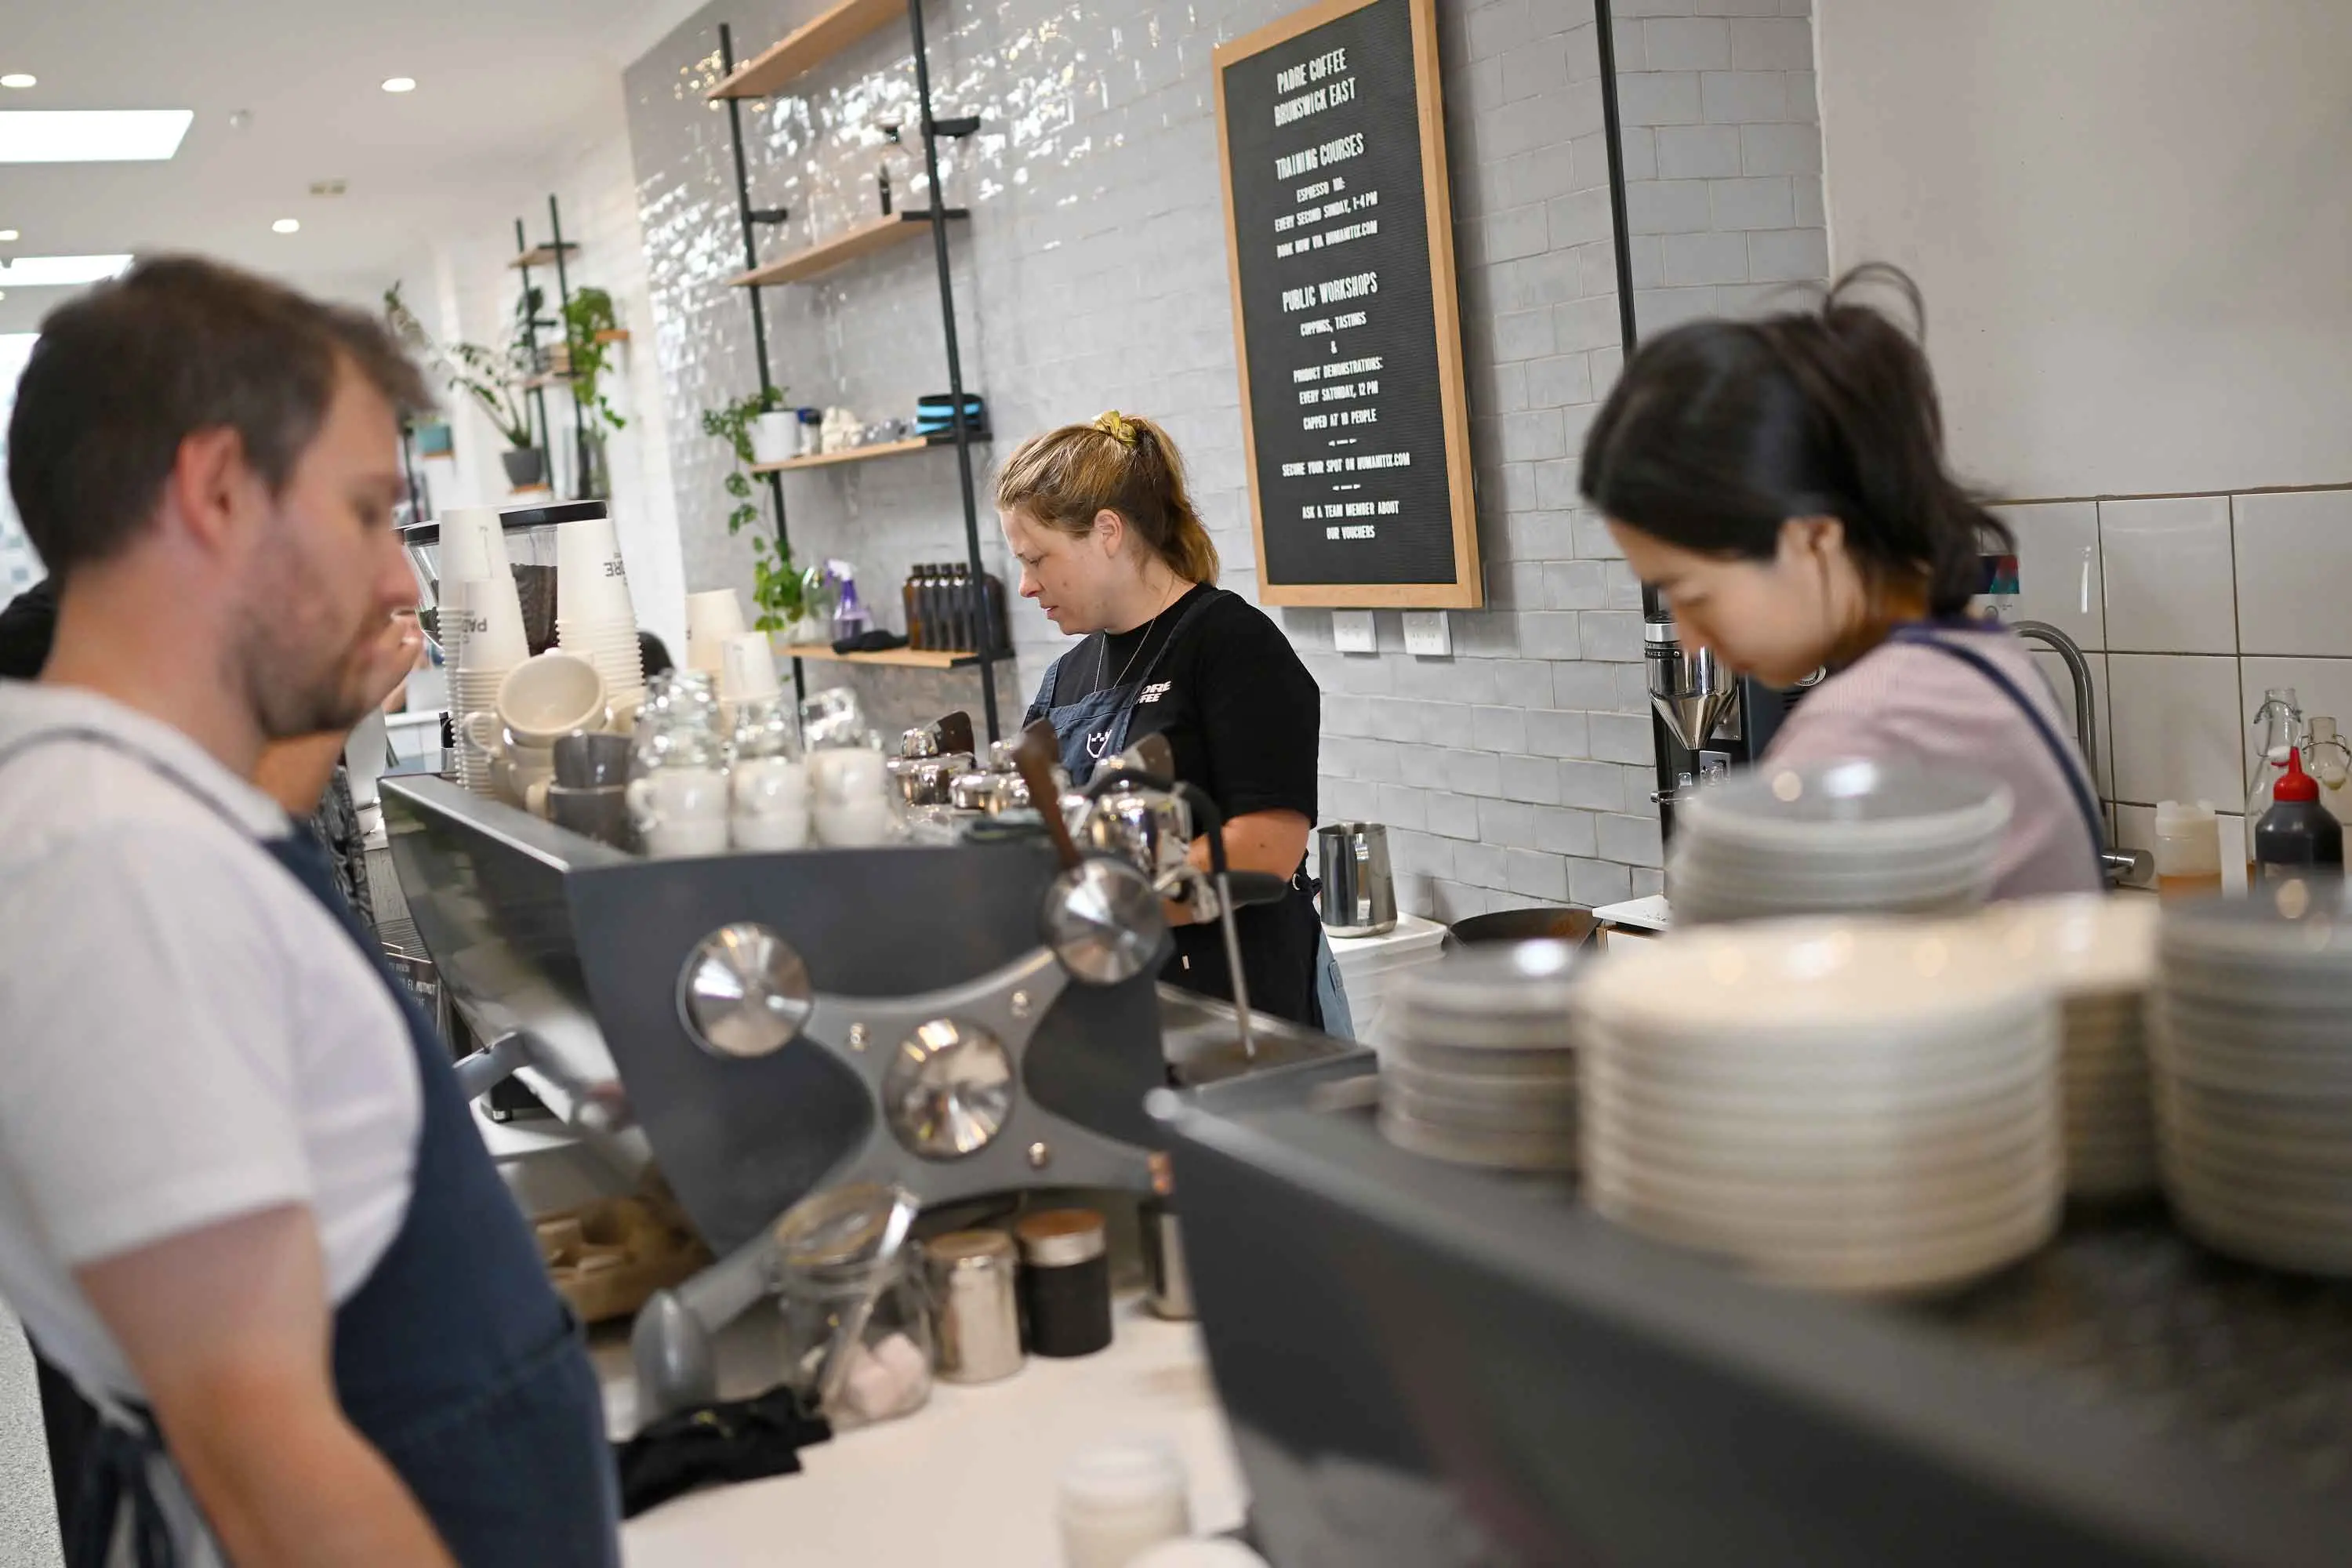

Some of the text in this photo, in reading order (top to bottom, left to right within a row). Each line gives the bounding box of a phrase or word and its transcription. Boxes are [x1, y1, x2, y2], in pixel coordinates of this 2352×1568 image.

[1277, 48, 1347, 94] PADRE COFFEE
[1274, 78, 1356, 127] BRUNSWICK EAST
[1275, 132, 1363, 180] TRAINING COURSES
[1297, 182, 1329, 202] ESPRESSO
[1275, 216, 1294, 232] EVERY
[1297, 208, 1322, 226] SECOND
[1282, 271, 1377, 313] PUBLIC WORKSHOPS
[1334, 311, 1367, 330] TASTINGS
[1294, 366, 1320, 383] PRODUCT
[1299, 390, 1319, 405] EVERY
[1303, 415, 1327, 430] CAPPED
[1330, 413, 1338, 426] AT
[1351, 408, 1377, 424] PEOPLE
[1282, 463, 1305, 477] SECURE
[1308, 460, 1324, 474] YOUR
[1327, 459, 1343, 472] SPOT
[1345, 457, 1355, 470] ON
[1302, 500, 1399, 519] ASK A TEAM MEMBER ABOUT
[1341, 525, 1375, 539] VOUCHERS
